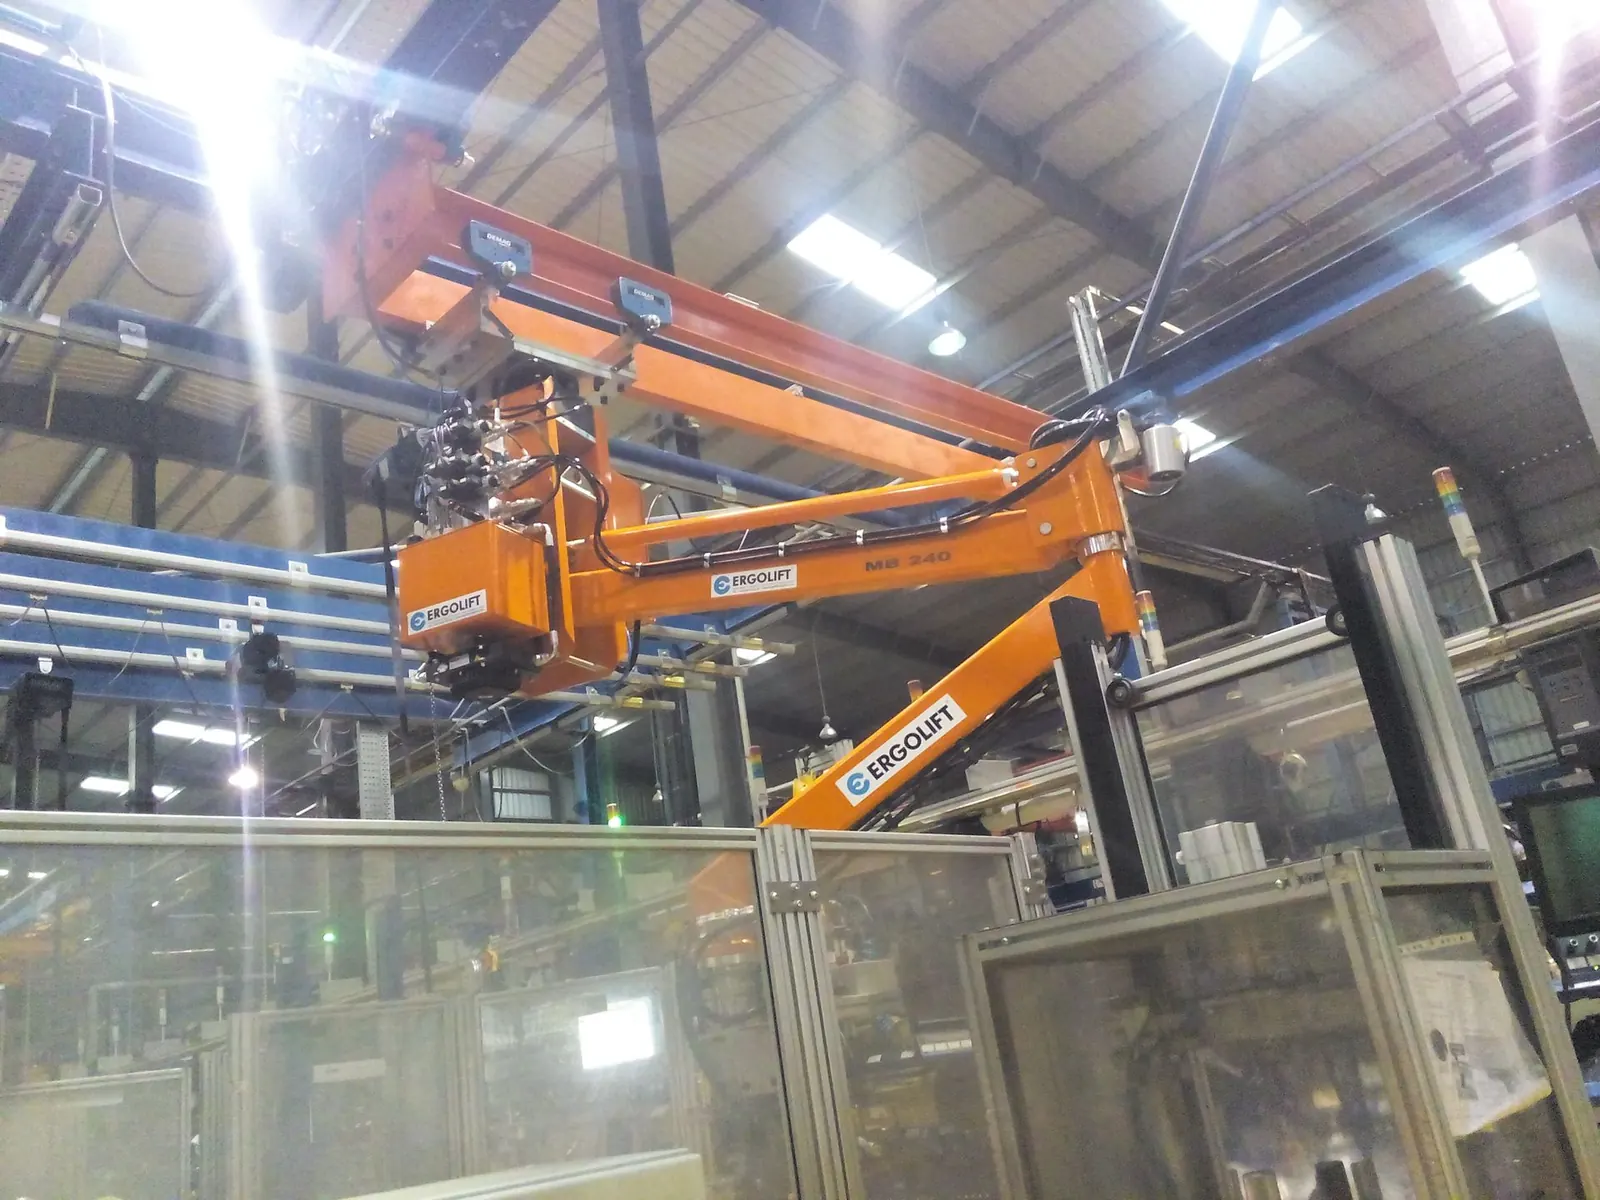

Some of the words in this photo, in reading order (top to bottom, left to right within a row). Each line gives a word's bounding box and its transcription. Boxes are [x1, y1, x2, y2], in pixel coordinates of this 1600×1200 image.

[865, 558, 899, 572] MB
[908, 550, 951, 567] 240
[732, 569, 791, 586] ERGOLIFT
[427, 594, 480, 620] ERGOLIFT
[866, 704, 954, 780] ERGOLIFT
